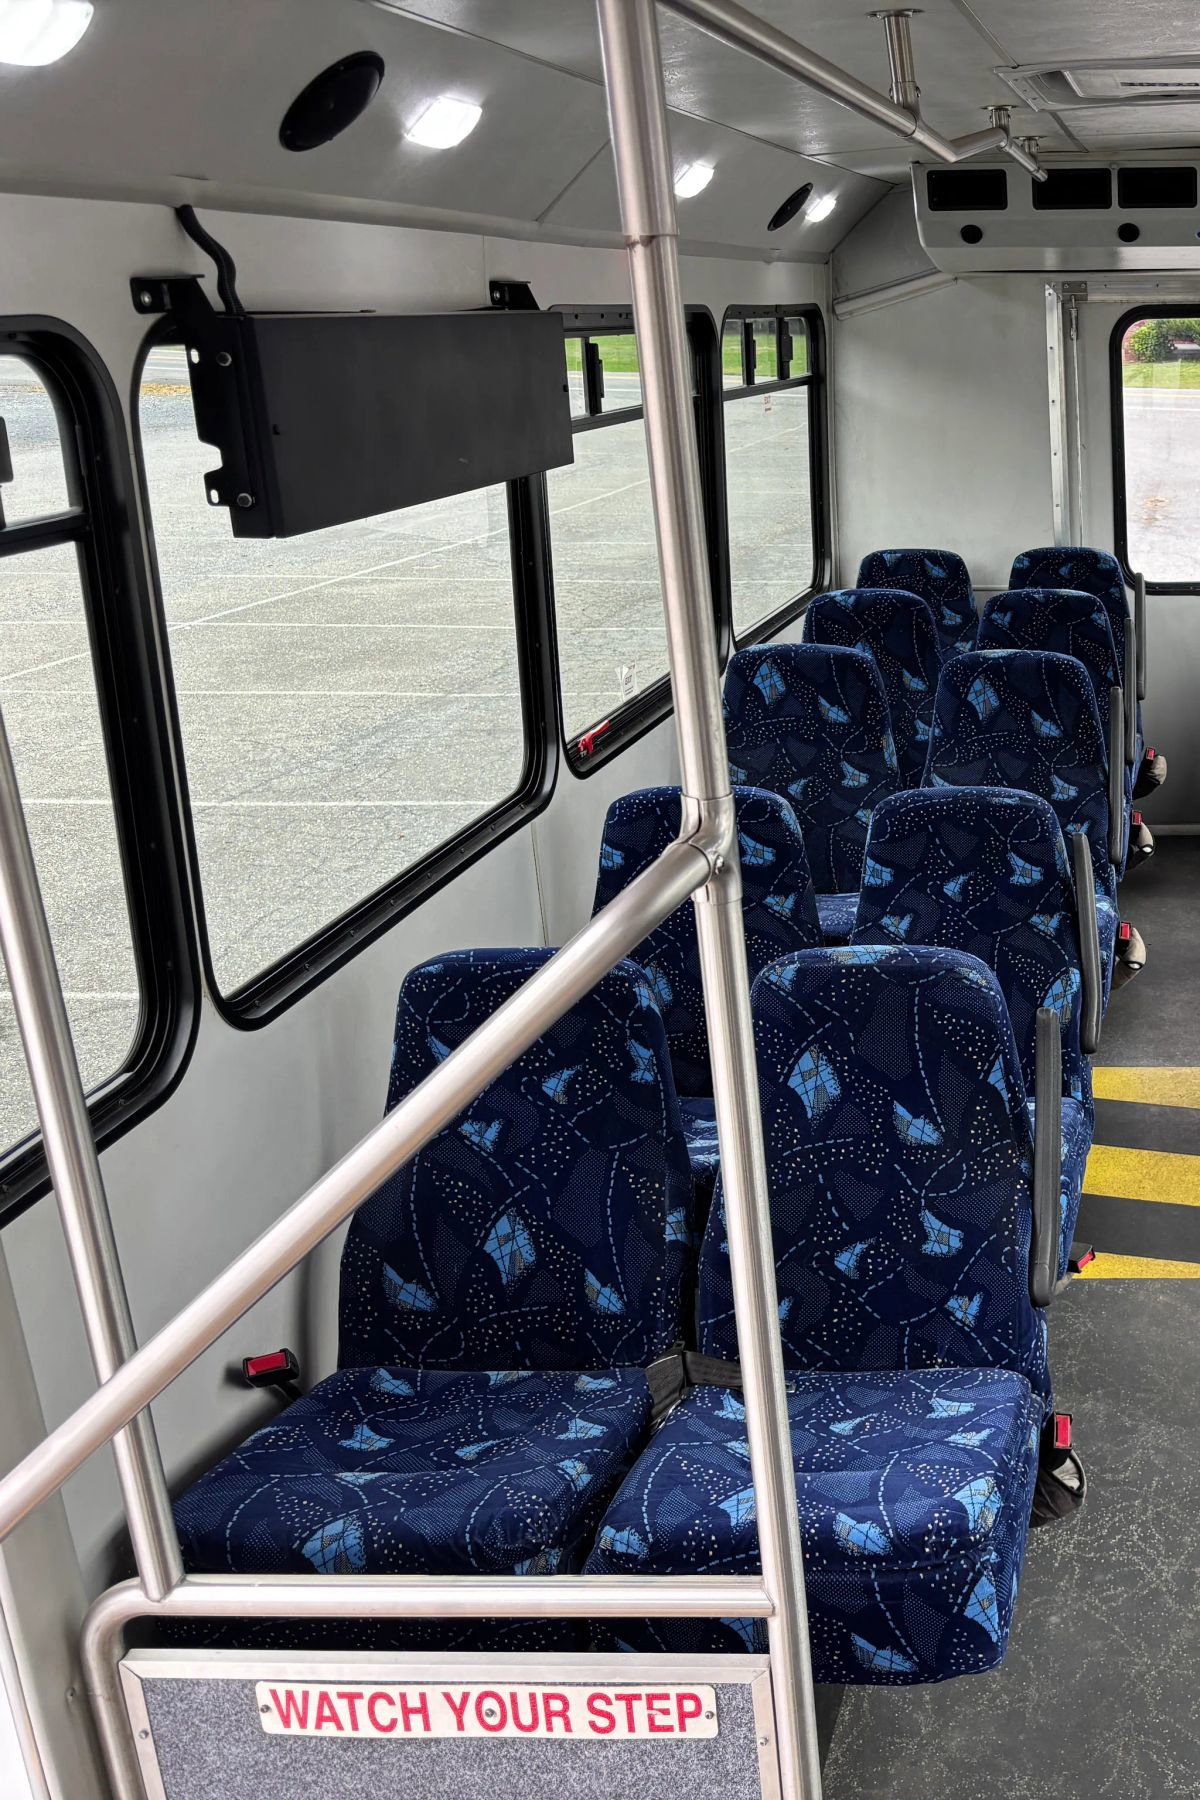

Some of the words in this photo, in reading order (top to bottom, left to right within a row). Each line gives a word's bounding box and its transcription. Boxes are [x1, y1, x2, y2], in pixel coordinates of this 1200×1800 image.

[269, 1688, 432, 1732] WATCH
[441, 1691, 573, 1733] YOUR
[586, 1692, 703, 1733] STEP
